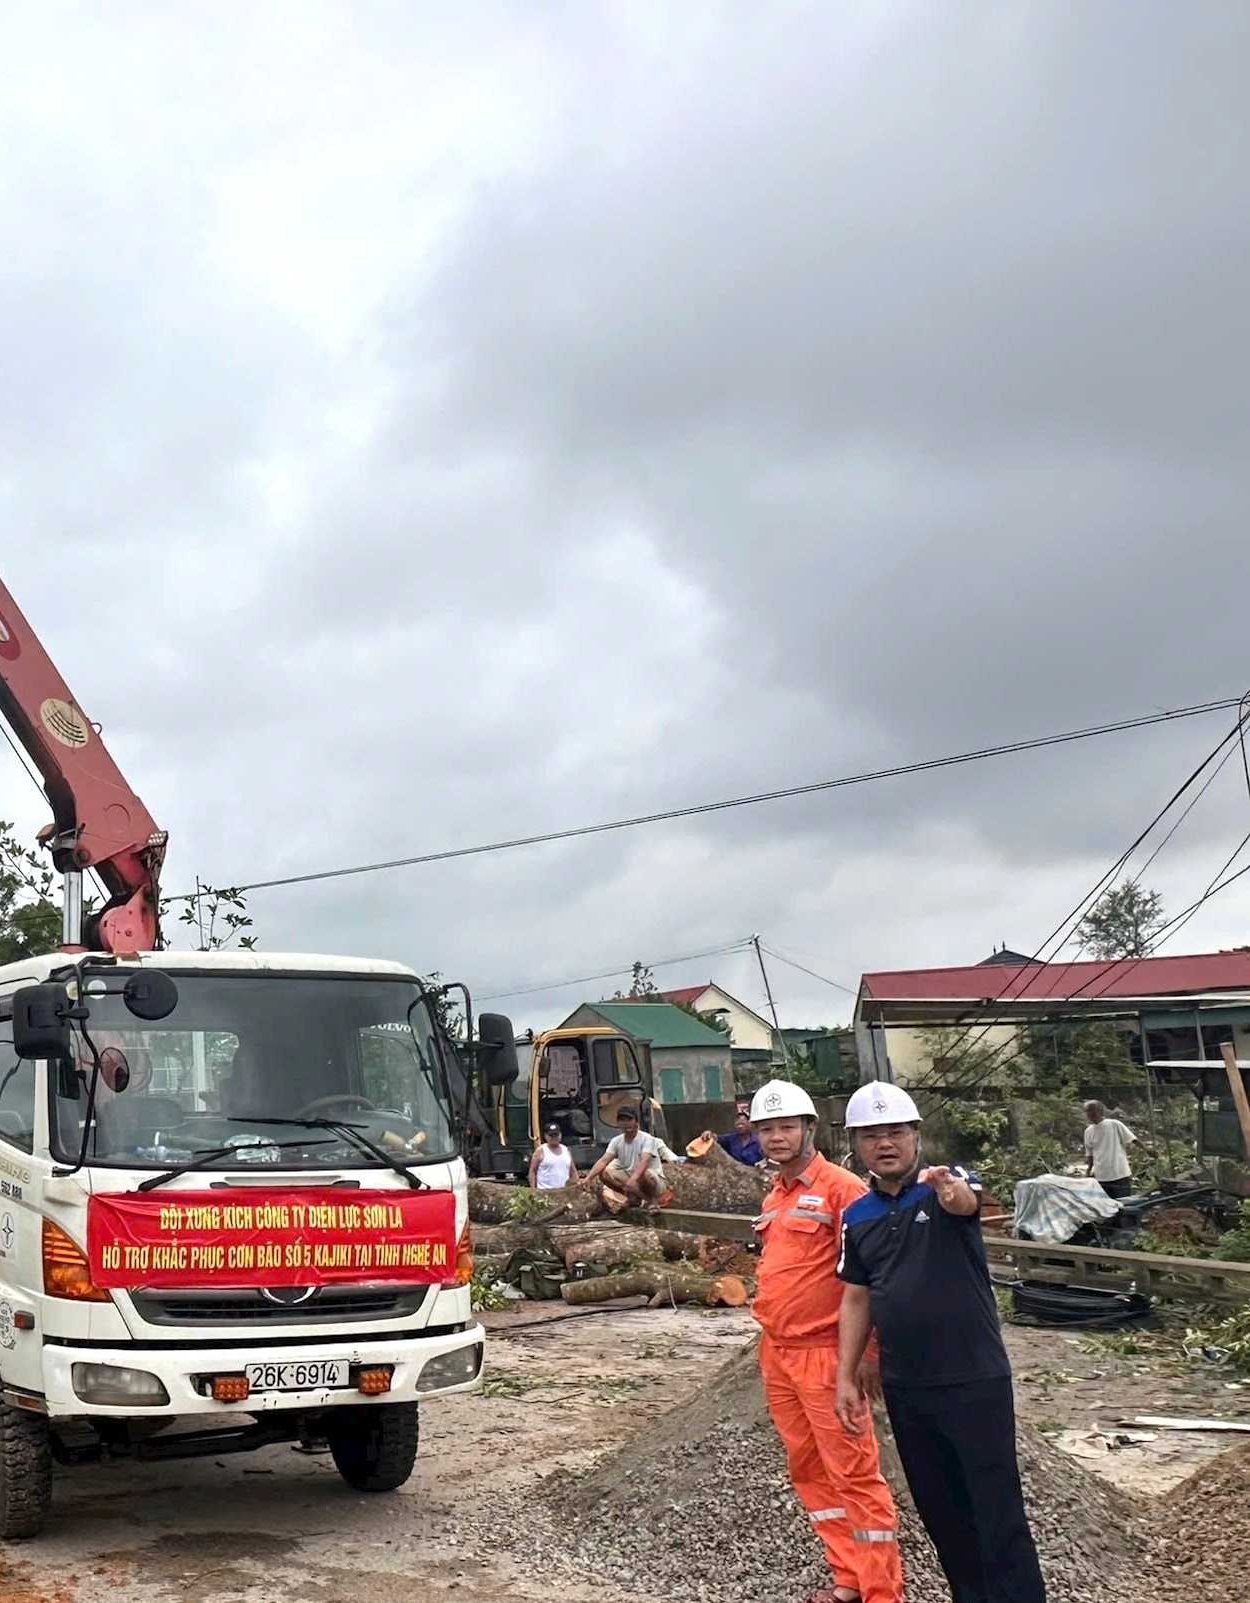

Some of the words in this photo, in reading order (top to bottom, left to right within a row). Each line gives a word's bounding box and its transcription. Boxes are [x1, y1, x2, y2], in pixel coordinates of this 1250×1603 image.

[160, 1203, 182, 1235] ĐỘI
[185, 1206, 220, 1230] XUNG
[223, 1202, 253, 1230] KÍCH
[255, 1201, 289, 1229] CÔNG
[292, 1205, 307, 1228] TY
[309, 1201, 337, 1233] ĐIỆN
[338, 1204, 361, 1233] LỰC
[363, 1204, 387, 1229] SƠN
[389, 1206, 403, 1228] LA
[124, 1244, 150, 1274] TRỢ
[152, 1238, 187, 1269] KHẮC
[190, 1245, 225, 1274] PHỤC
[228, 1244, 254, 1268] CƠN
[257, 1240, 282, 1268] BÃO
[285, 1236, 302, 1267] SỐ
[303, 1244, 311, 1267] 5
[314, 1244, 351, 1267] KAJIKI
[355, 1244, 372, 1271] TẠI
[375, 1236, 400, 1266] TỈNH
[402, 1239, 431, 1271] NGHỆ
[432, 1243, 447, 1266] AN
